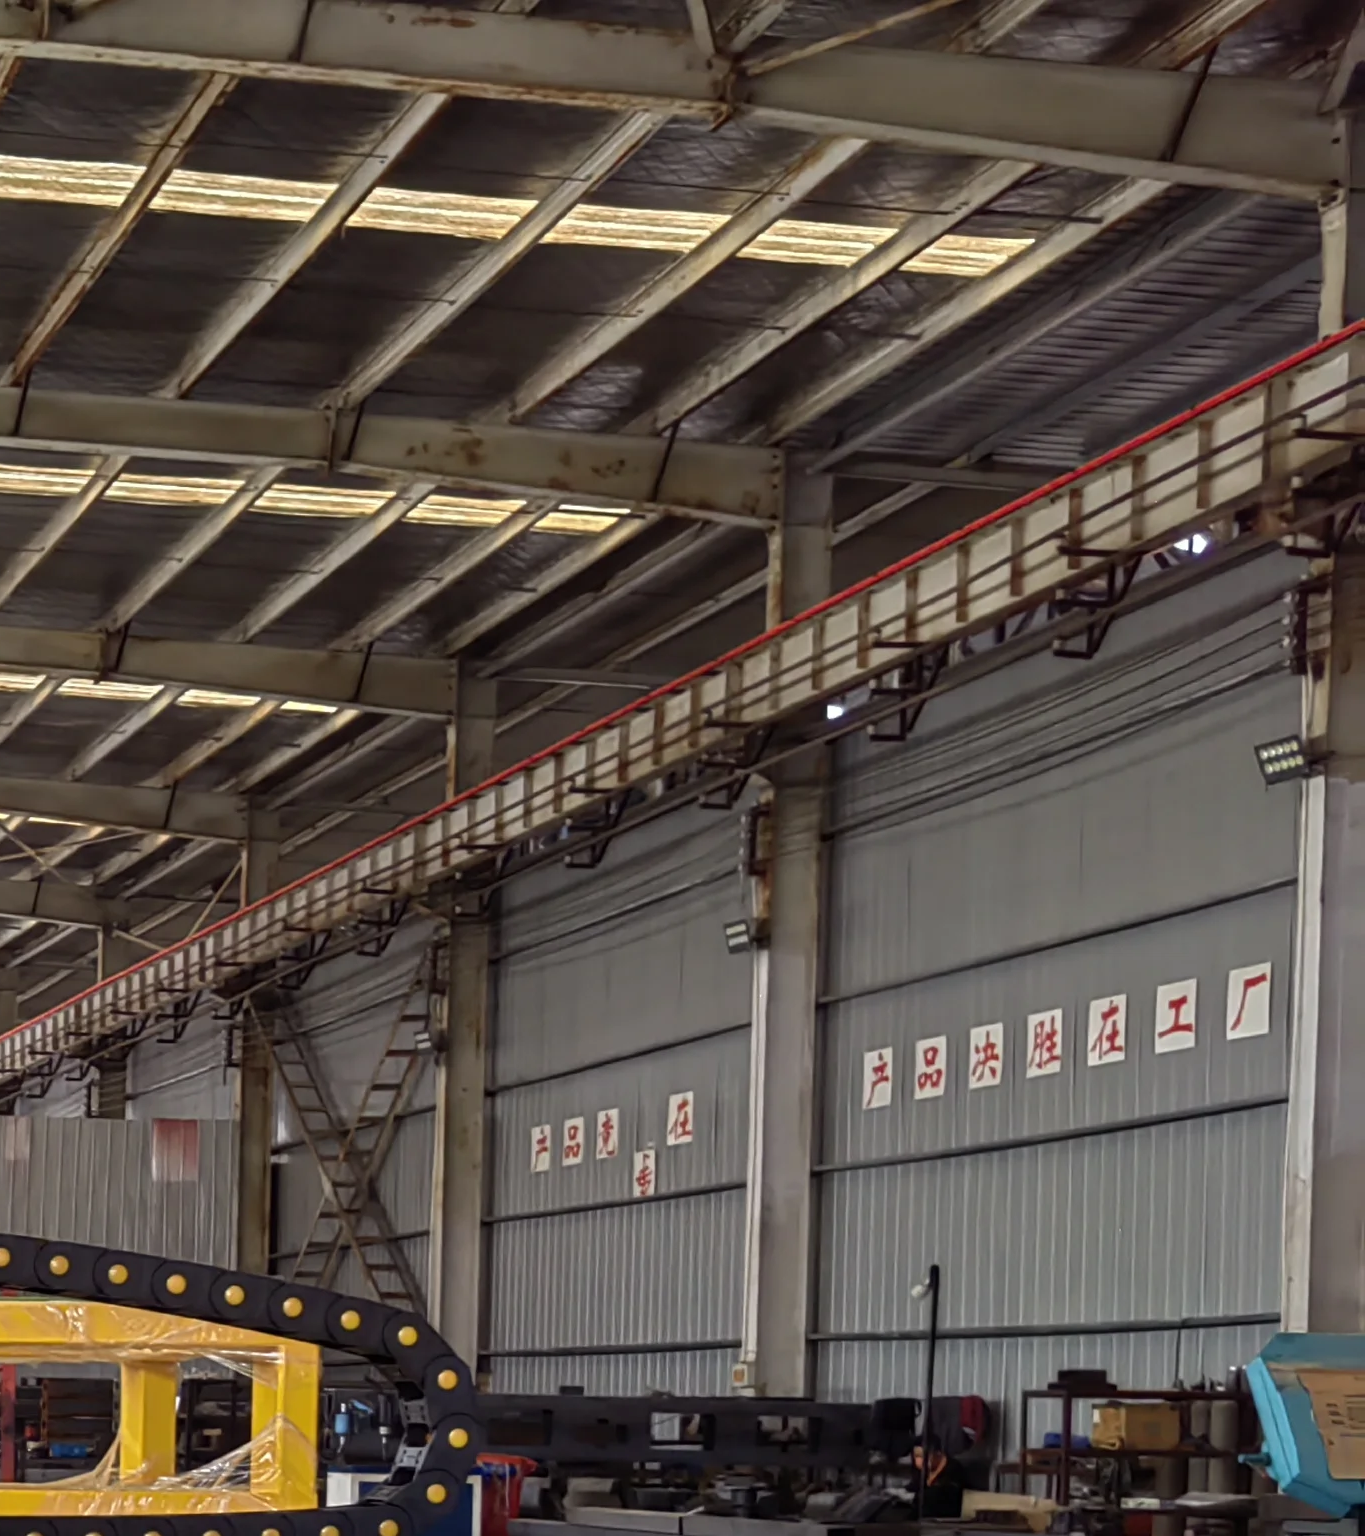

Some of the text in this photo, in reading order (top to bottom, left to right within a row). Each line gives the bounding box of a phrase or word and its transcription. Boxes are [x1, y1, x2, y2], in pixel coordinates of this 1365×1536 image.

[865, 973, 1268, 1107] 产品决胜在工厂
